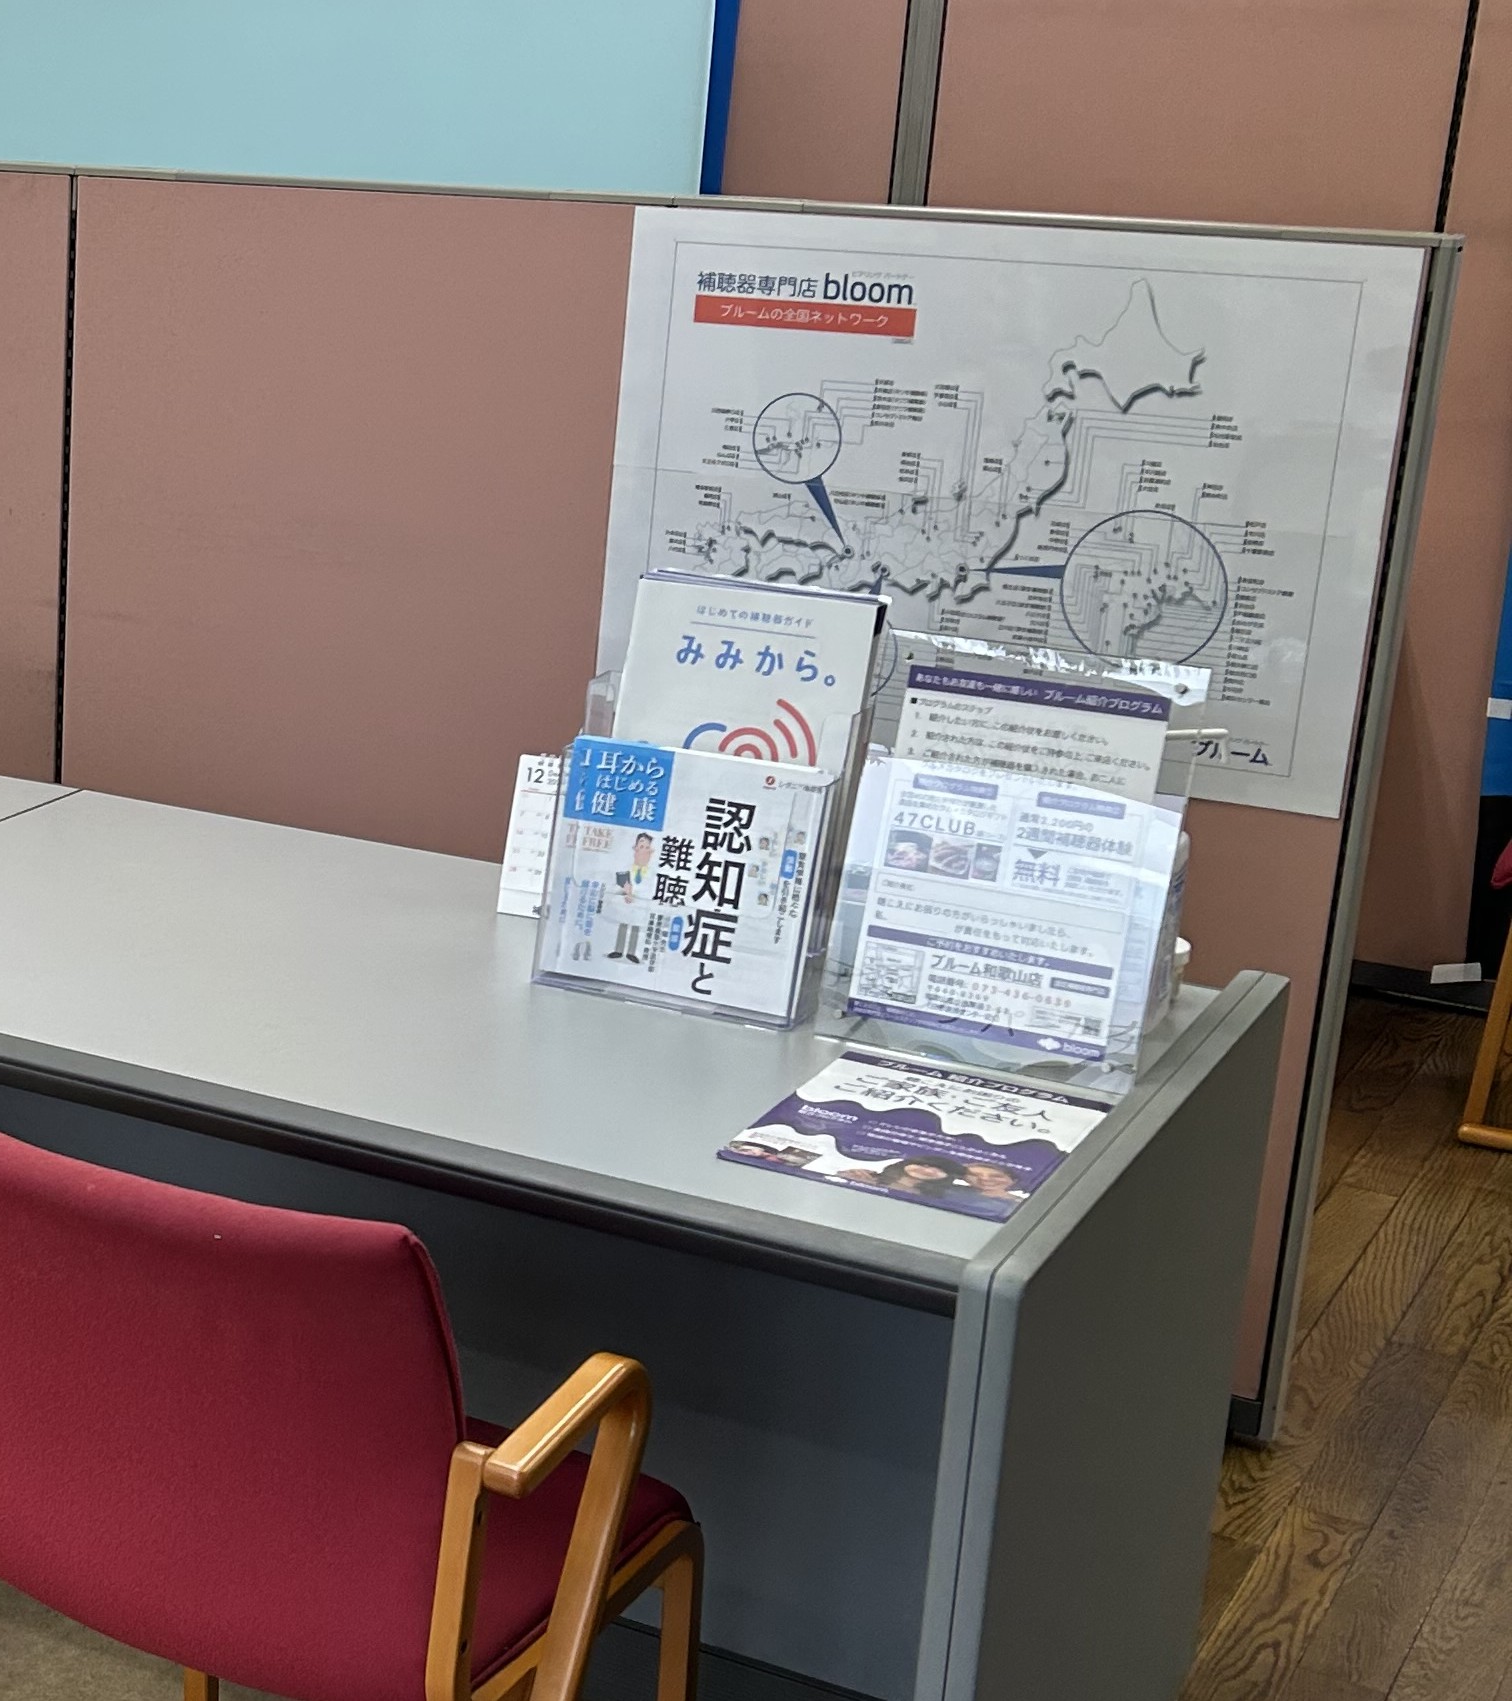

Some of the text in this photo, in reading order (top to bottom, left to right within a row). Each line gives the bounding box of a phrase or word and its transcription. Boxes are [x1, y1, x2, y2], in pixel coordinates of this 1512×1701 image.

[697, 271, 914, 305] 補聴器専門店 bloom
[720, 304, 889, 328] ブルームの全国ネットワーク
[676, 635, 836, 687] みみから。
[1044, 689, 1163, 714] ブルーム紹介プログラム
[526, 767, 545, 784] 12
[596, 751, 665, 779] 耳から
[595, 774, 659, 796] はじめる
[893, 811, 976, 836] 47CLUB
[653, 835, 695, 908] 難聴
[1013, 859, 1062, 887] 無料
[681, 797, 756, 996] 認知症と
[834, 1082, 1051, 1134] ご紹介ください。
[856, 1073, 1054, 1123] ご家族・ご友人
